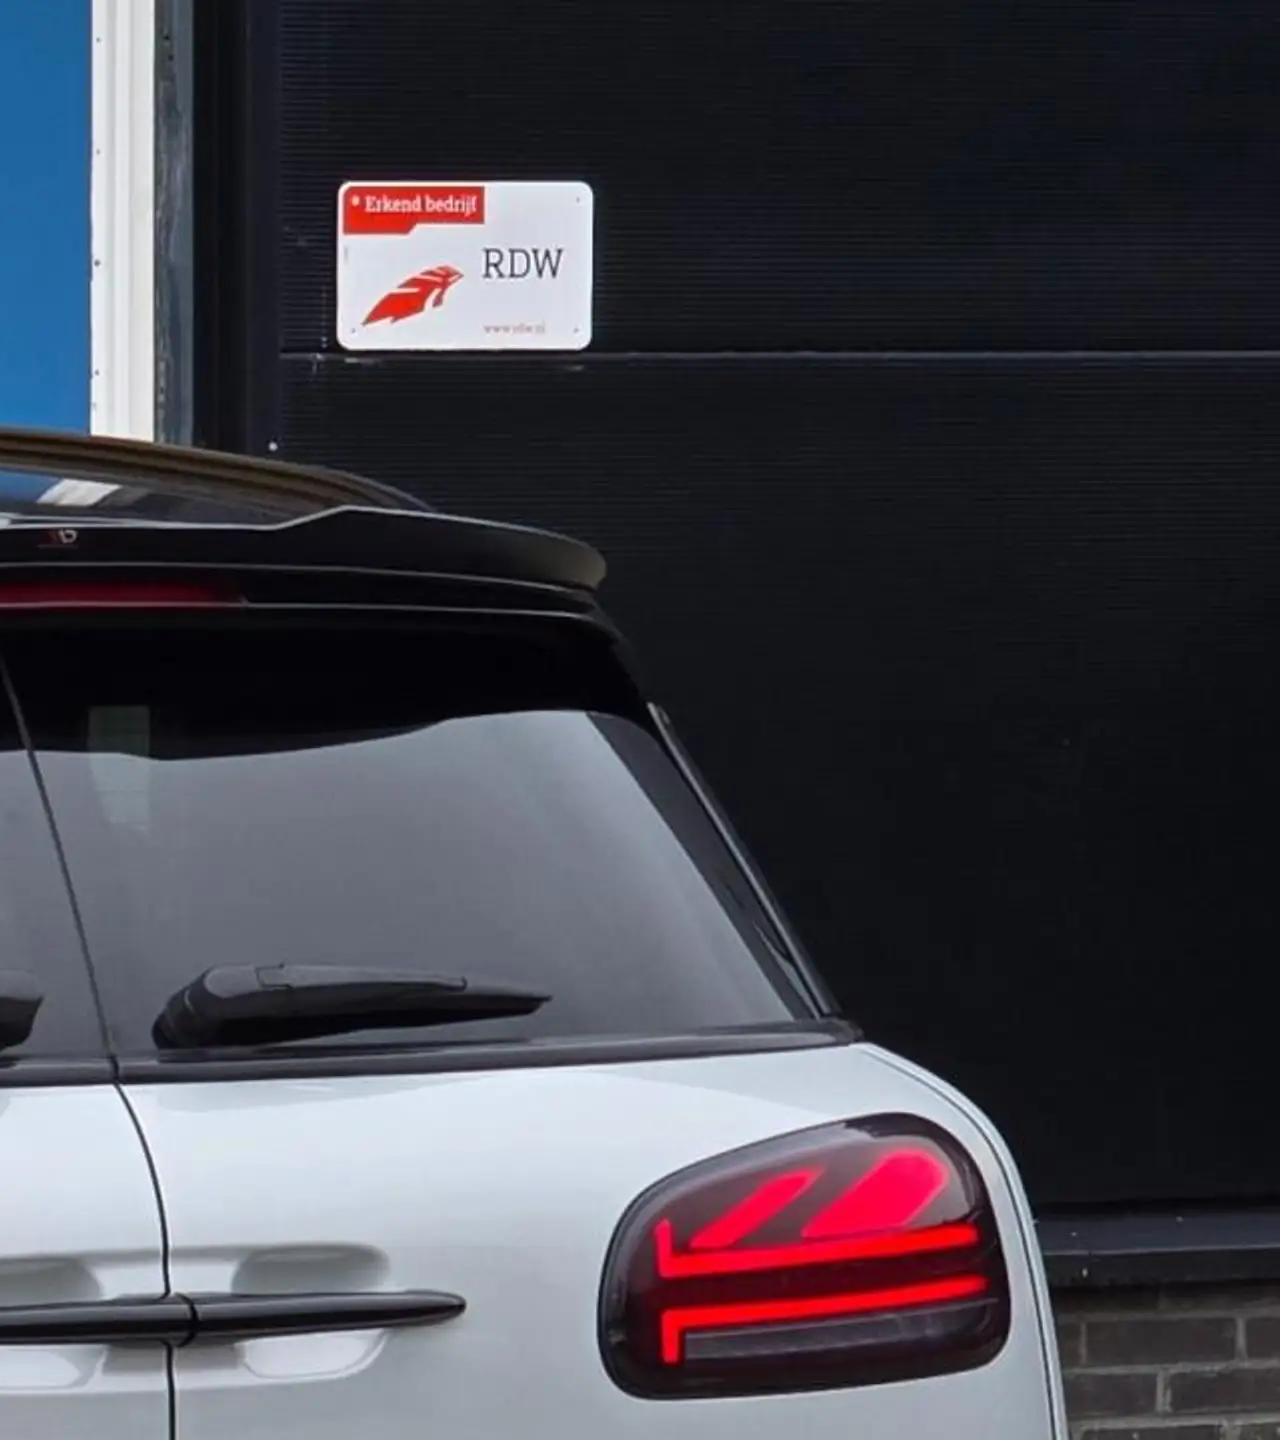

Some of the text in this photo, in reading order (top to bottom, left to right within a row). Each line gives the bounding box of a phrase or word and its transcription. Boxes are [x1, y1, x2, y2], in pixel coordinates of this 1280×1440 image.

[365, 194, 477, 217] Erkend bedrijf
[483, 248, 563, 278] RDW
